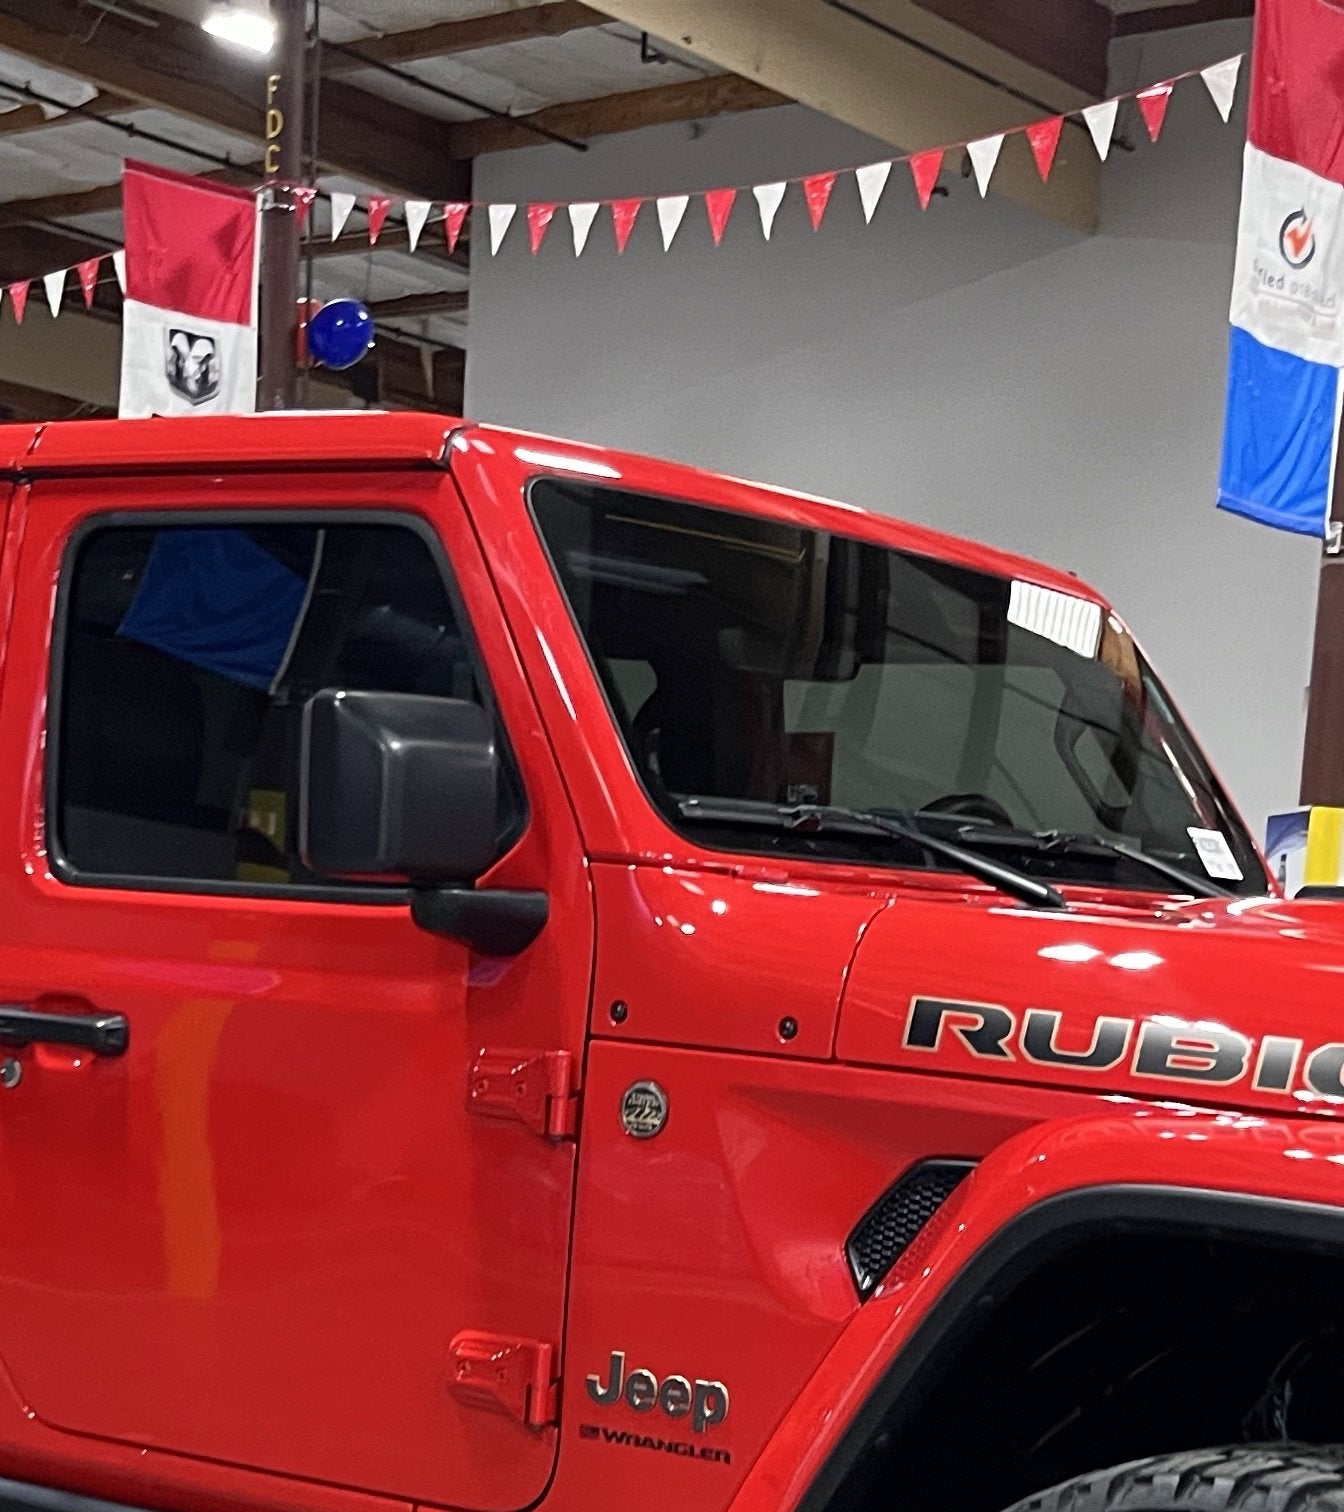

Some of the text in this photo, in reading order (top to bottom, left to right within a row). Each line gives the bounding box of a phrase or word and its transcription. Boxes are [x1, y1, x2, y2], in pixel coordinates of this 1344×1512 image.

[265, 73, 284, 174] FDC
[585, 1350, 730, 1434] Jeep
[600, 1426, 732, 1465] WRANGLER
